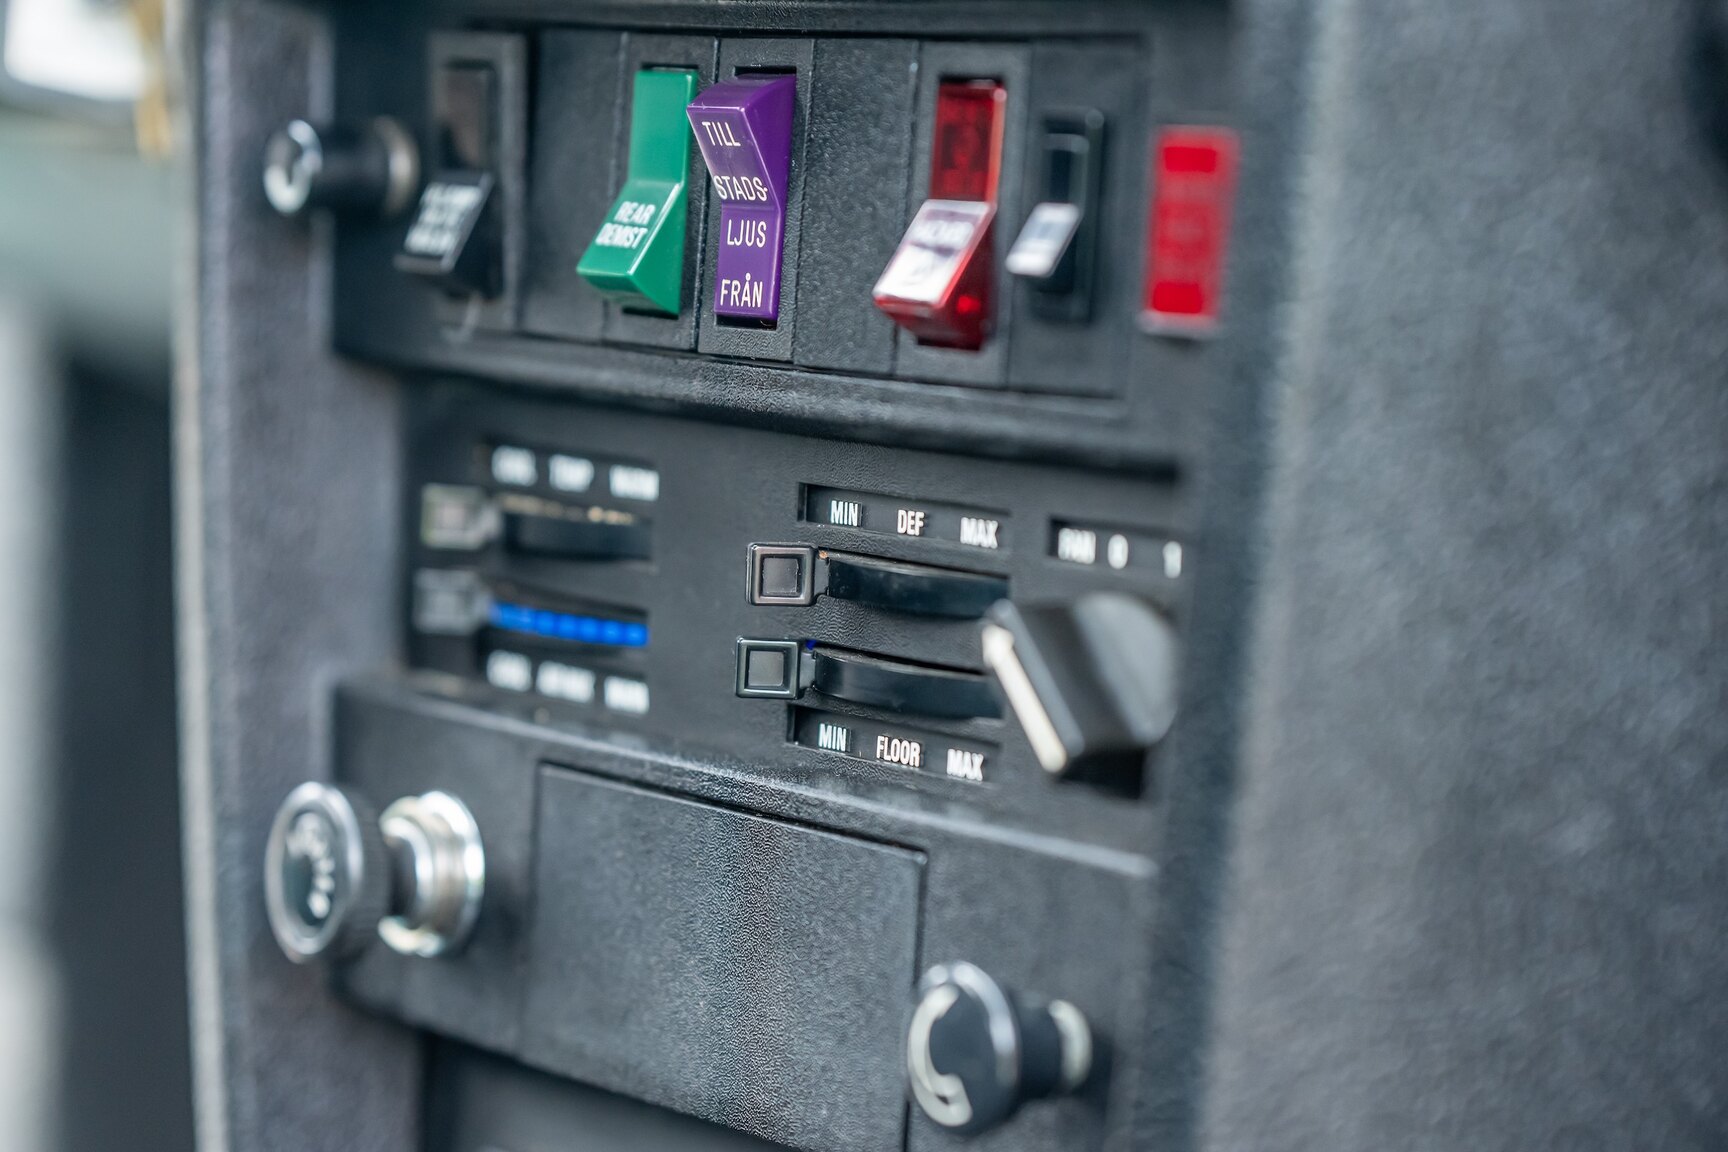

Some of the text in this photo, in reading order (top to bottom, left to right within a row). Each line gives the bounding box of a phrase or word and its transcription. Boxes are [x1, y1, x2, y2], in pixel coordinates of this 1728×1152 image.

[702, 121, 741, 146] TILL
[614, 201, 656, 225] REAR
[595, 223, 648, 249] DEMIST
[727, 219, 766, 247] LJUS
[720, 273, 763, 308] FRÅN
[830, 500, 999, 549] MIN DEF MAX
[818, 722, 984, 782] MIN FLOOR MAX
